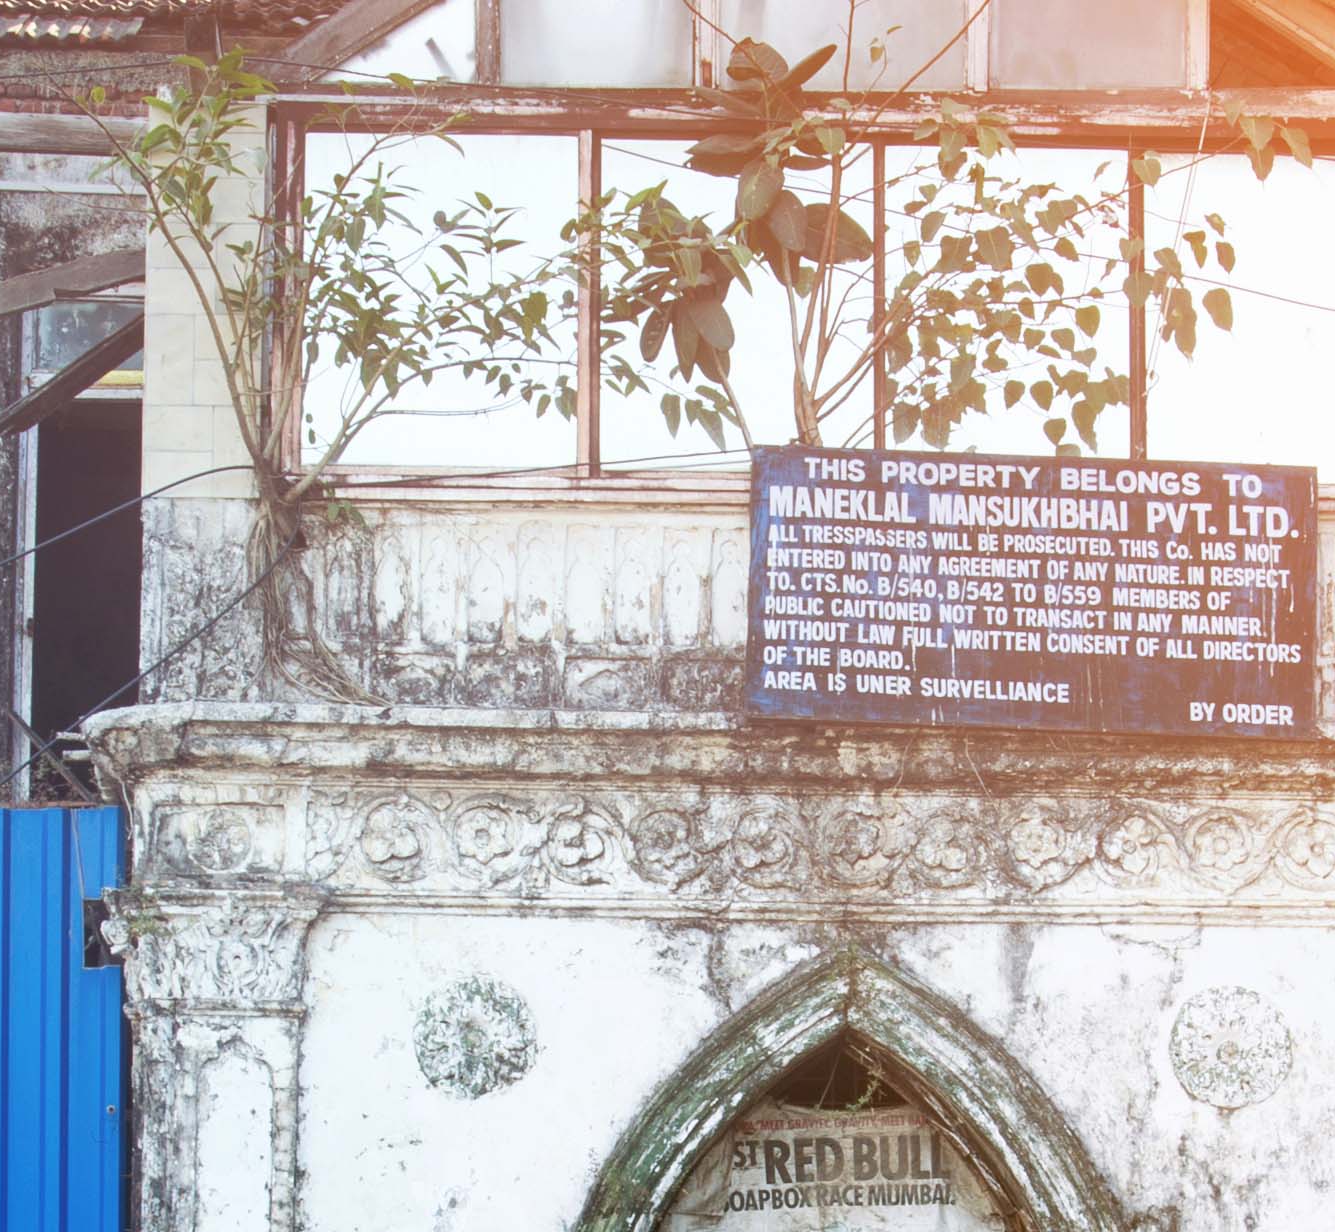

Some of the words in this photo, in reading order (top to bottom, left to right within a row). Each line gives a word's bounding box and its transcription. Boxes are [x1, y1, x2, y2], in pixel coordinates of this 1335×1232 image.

[805, 457, 866, 482] THIS
[881, 461, 1041, 490] PROPERTY
[1060, 467, 1201, 496] BELONGS
[1222, 473, 1263, 499] TO
[769, 485, 917, 524] MANEKLAL
[928, 493, 1129, 532] MANSUKHBHAI
[1147, 501, 1218, 535] PVT.
[1228, 504, 1300, 539] LTD.
[768, 524, 799, 544] ALL
[802, 525, 928, 549] TRESSPASSERS
[932, 531, 972, 551] WILL
[977, 533, 999, 552] BE
[1003, 533, 1116, 557] PROSECUTED.
[1119, 538, 1160, 559] THIS
[1165, 540, 1193, 561] Co.
[1201, 542, 1236, 561] HAS
[1244, 543, 1282, 563] NOT
[766, 547, 846, 570] ENTERED
[851, 550, 892, 572] INTO
[897, 553, 933, 575] ANY
[938, 556, 1041, 579] AGREEMENT
[1046, 559, 1069, 581] OF
[1073, 560, 1109, 582] ANY
[1210, 566, 1291, 589] RESPECT
[767, 571, 796, 592] TO.
[1011, 582, 1037, 603] TO
[1043, 581, 1102, 607] B/559
[1111, 587, 1201, 611] MEMBERS
[1206, 590, 1232, 612] OF
[765, 595, 825, 617] PUBLIC
[830, 597, 931, 622] CAUTIONED
[938, 603, 977, 625] NOT
[982, 605, 1009, 626] TO
[1013, 606, 1107, 630] TRANSACT
[1112, 611, 1133, 631] IN
[1136, 612, 1174, 633] ANY
[763, 619, 850, 643] WITHOUT
[857, 622, 896, 646] LAW
[902, 626, 949, 649] FULL
[952, 627, 1042, 652] WRITTEN
[1046, 631, 1131, 657] CONSENT
[1135, 636, 1161, 658] OF
[1165, 638, 1199, 661] ALL
[1202, 639, 1302, 665] DIRECTORS
[763, 645, 788, 666] OF
[792, 646, 832, 667] THE
[839, 648, 911, 672] BOARD.
[763, 670, 818, 692] AREA
[826, 672, 847, 694] IS
[856, 674, 913, 697] UNER
[919, 676, 1071, 705] SURVELLIANCE
[1189, 701, 1217, 723] BY
[1221, 702, 1295, 727] ORDER
[764, 1137, 845, 1184] RED
[852, 1134, 952, 1182] BULL
[814, 1183, 864, 1208] RACE
